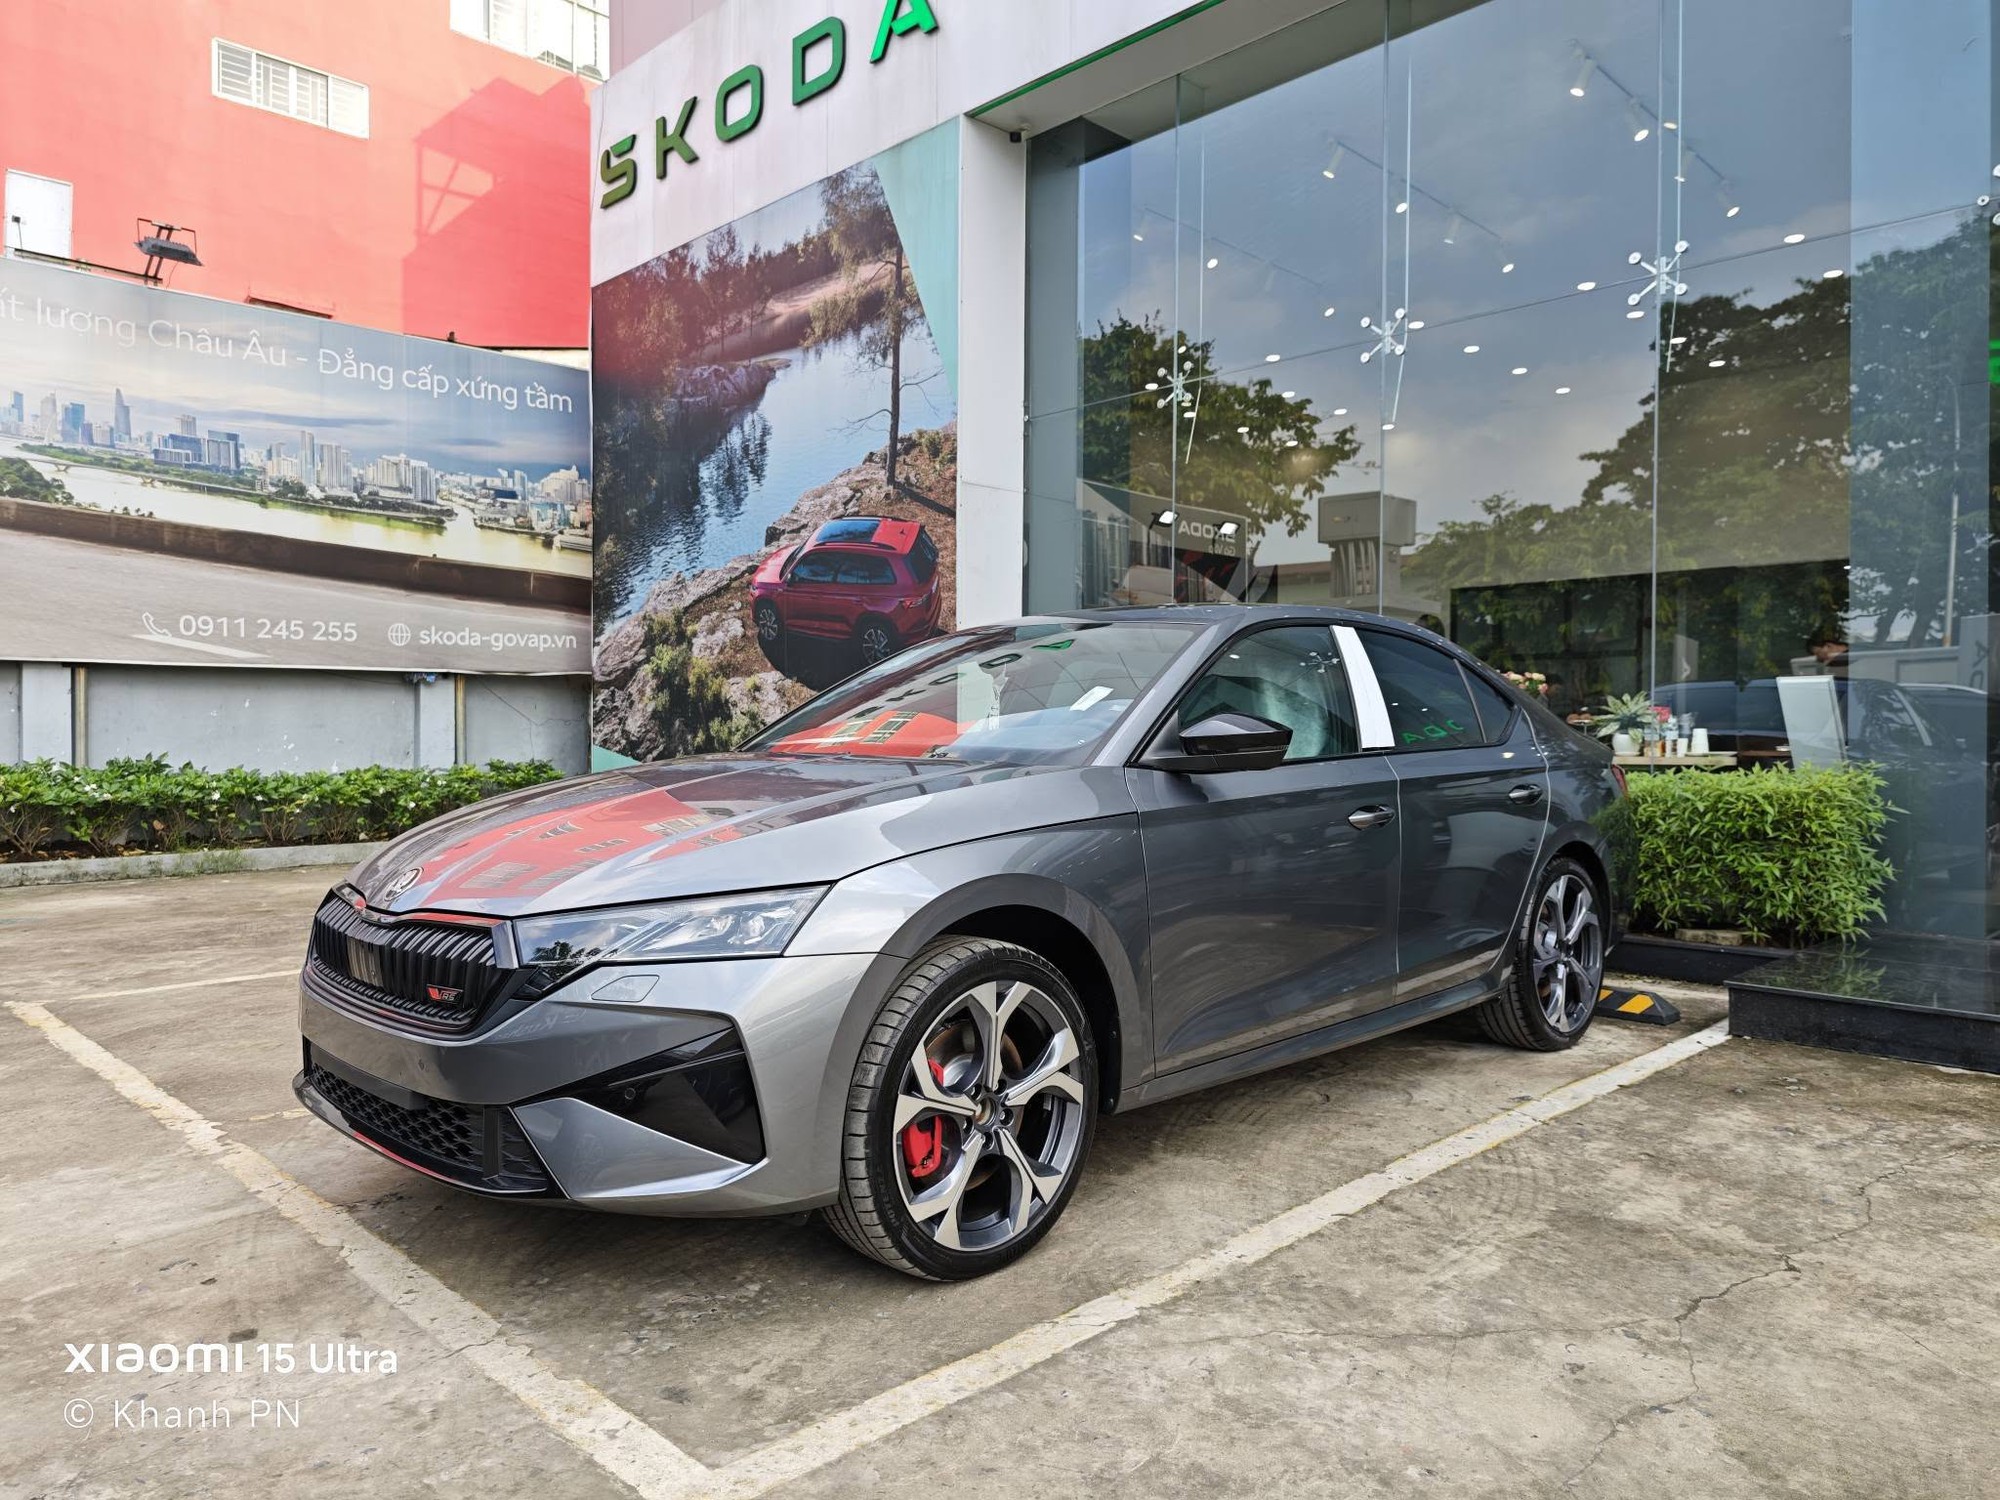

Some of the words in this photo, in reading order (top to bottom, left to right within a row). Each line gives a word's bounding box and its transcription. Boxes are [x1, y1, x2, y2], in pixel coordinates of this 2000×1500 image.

[37, 297, 136, 348] lượng
[149, 319, 233, 358] Châu
[243, 329, 286, 366] Âu
[318, 348, 393, 390] Đẳng
[402, 364, 449, 398] cấp
[456, 376, 518, 410] xứng
[525, 382, 572, 413] tầm
[179, 614, 245, 640] 0911
[257, 618, 304, 640] 245
[313, 620, 359, 642] 255
[419, 625, 577, 652] skoda-govap.vn
